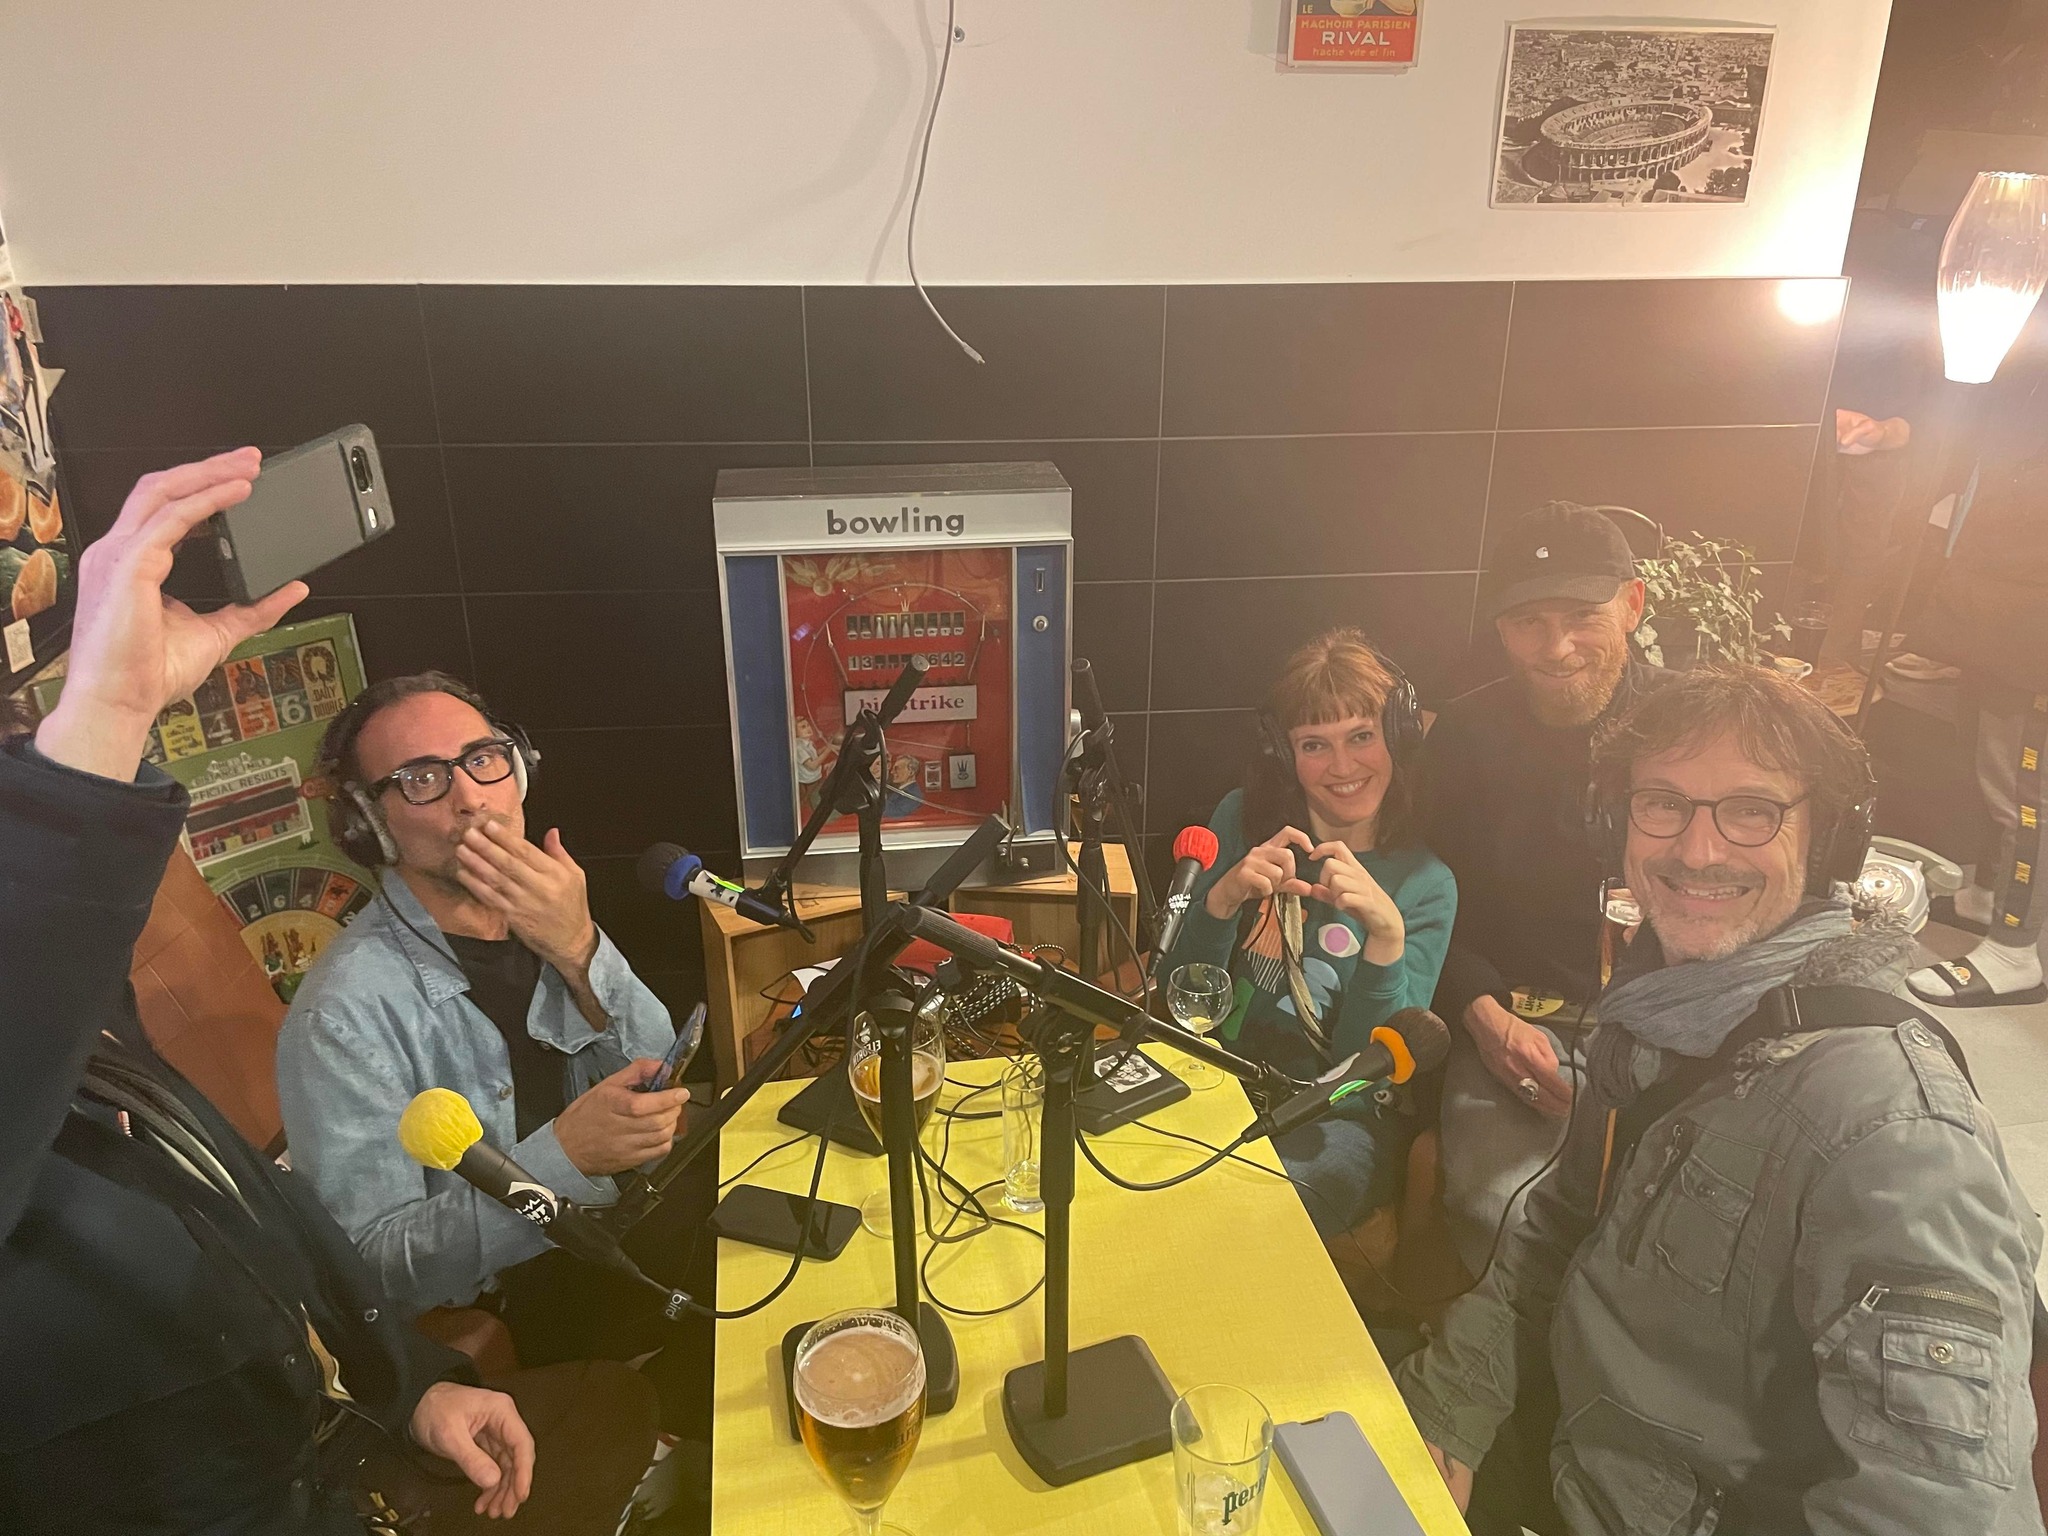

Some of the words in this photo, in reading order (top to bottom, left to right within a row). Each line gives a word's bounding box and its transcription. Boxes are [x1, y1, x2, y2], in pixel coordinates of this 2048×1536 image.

[1302, 4, 1314, 14] LE
[1357, 20, 1412, 30] PARISIEN
[1321, 31, 1391, 46] RIVAL
[1382, 48, 1396, 57] fin
[826, 507, 966, 537] bowling
[281, 694, 306, 725] 6
[2022, 746, 2038, 771] NIKE
[191, 780, 236, 801] FFICIAL
[239, 767, 288, 789] RESULTS
[2020, 805, 2037, 829] NIKE
[2015, 861, 2031, 884] NIKE
